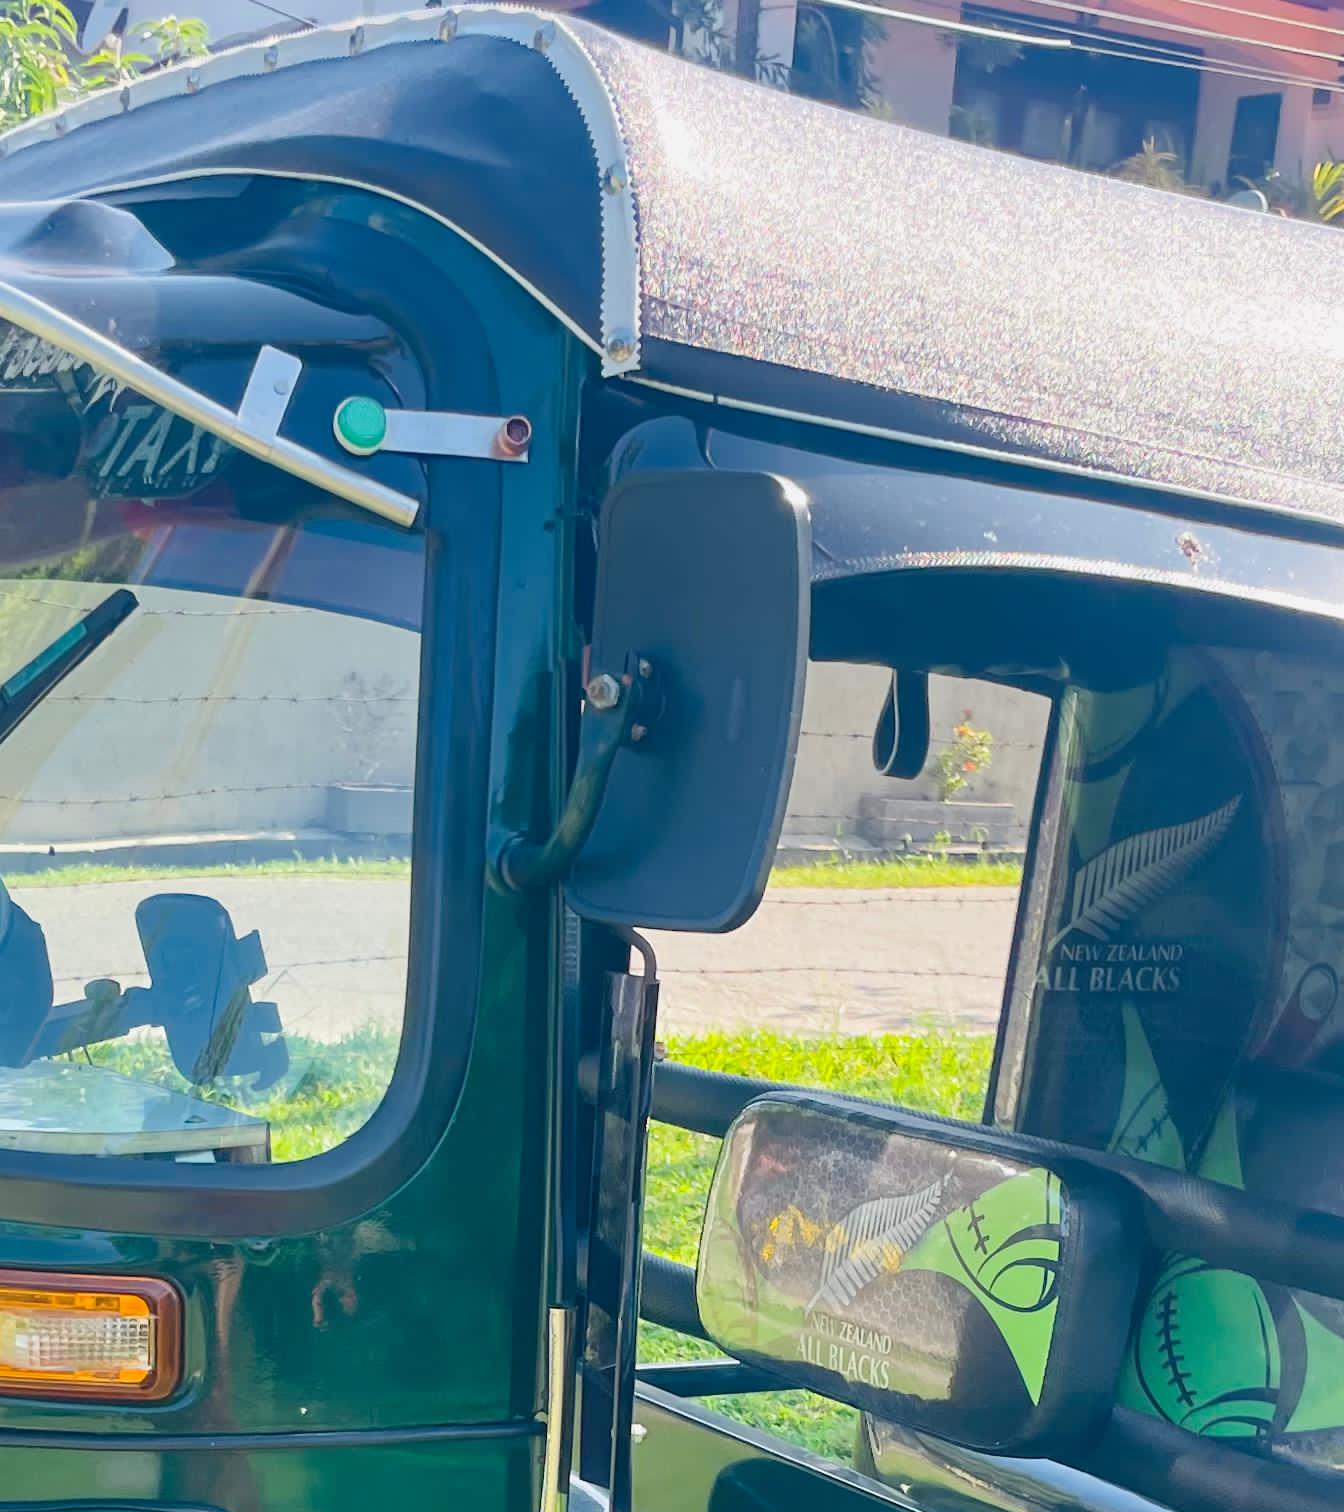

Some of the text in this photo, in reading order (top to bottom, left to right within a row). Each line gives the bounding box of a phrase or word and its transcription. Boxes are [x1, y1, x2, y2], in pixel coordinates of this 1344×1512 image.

[1059, 943, 1184, 962] NEW ZEALAND
[1035, 965, 1182, 993] ALL BLACKS
[810, 1311, 892, 1355] NEW ZEALAND
[798, 1332, 890, 1390] ALL BLACKS
